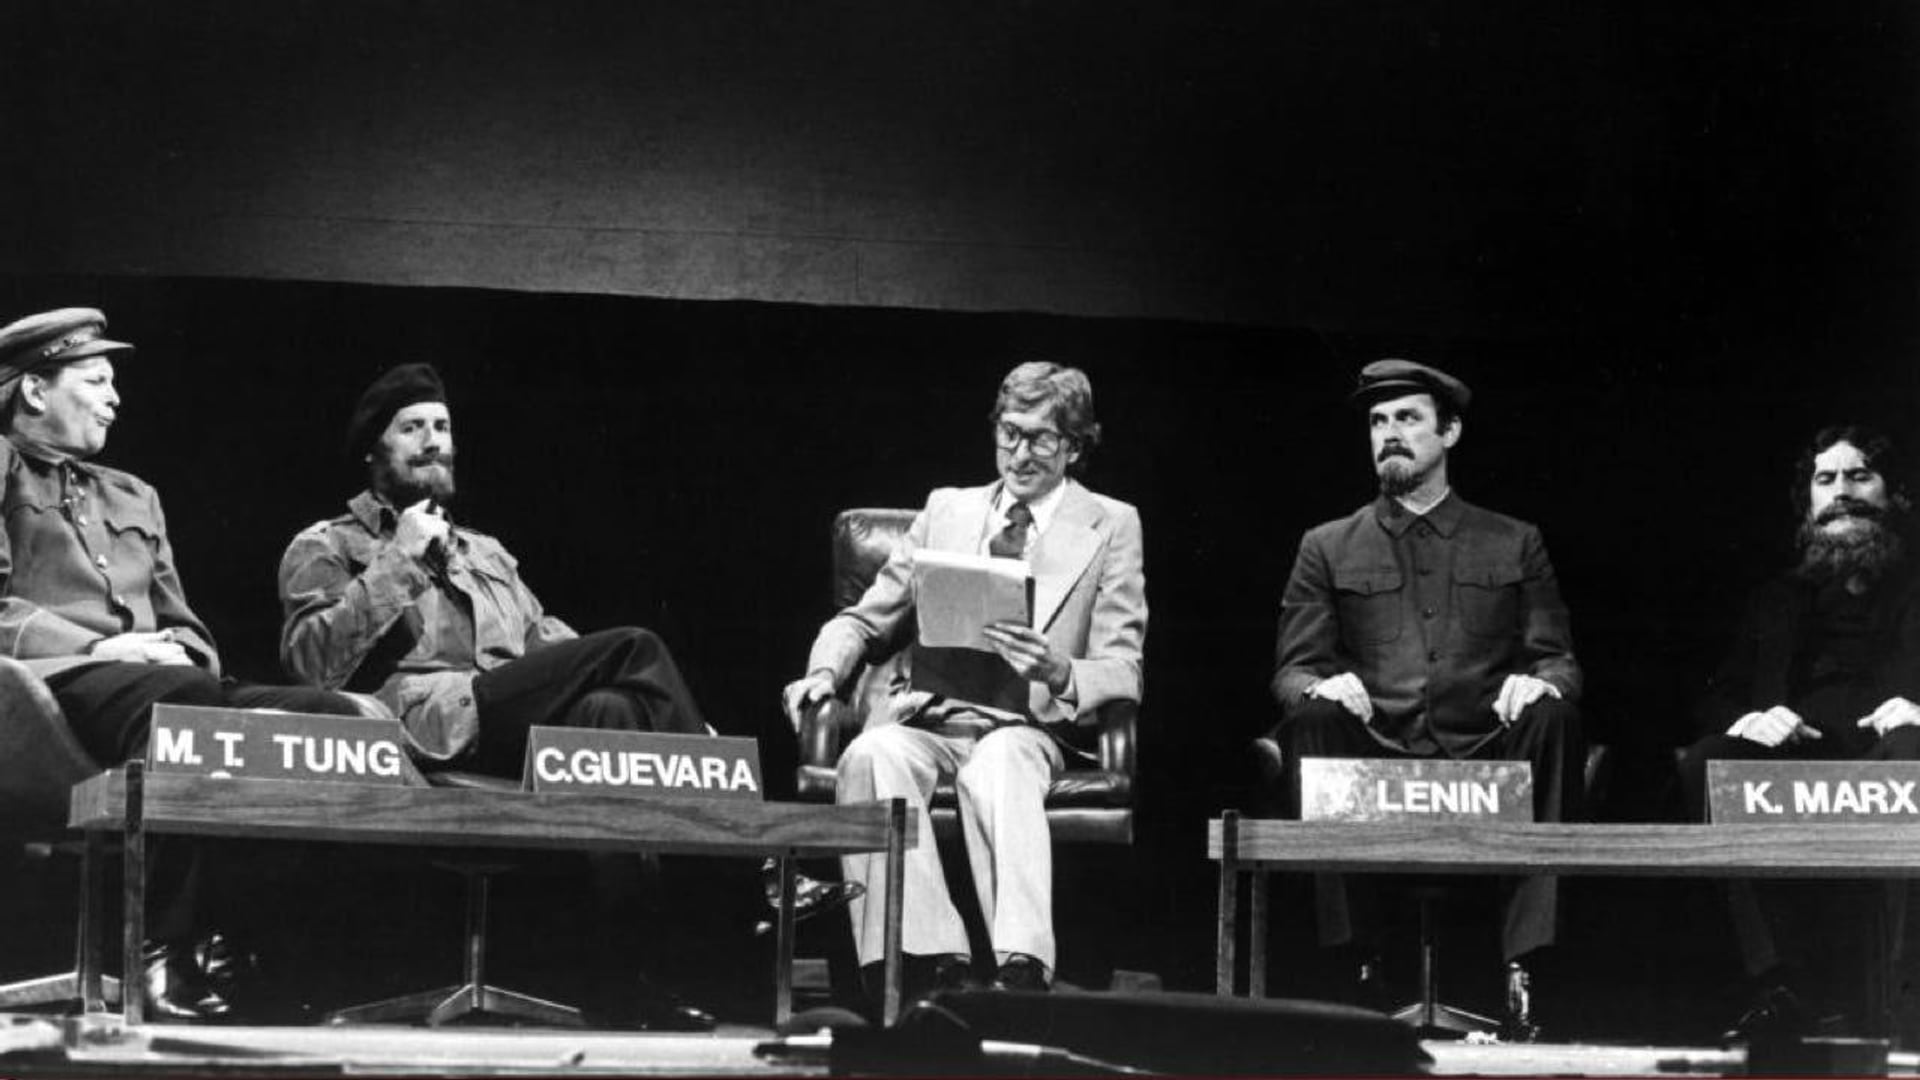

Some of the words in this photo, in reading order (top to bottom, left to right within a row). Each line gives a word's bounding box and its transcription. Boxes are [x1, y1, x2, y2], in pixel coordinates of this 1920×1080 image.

[156, 727, 202, 765] M.
[213, 731, 244, 767] T.
[272, 733, 400, 776] TUNG
[536, 747, 757, 791] C.GUEVARA
[1377, 779, 1499, 813] LENIN
[1743, 780, 1783, 813] K.
[1793, 776, 1918, 813] MARX
